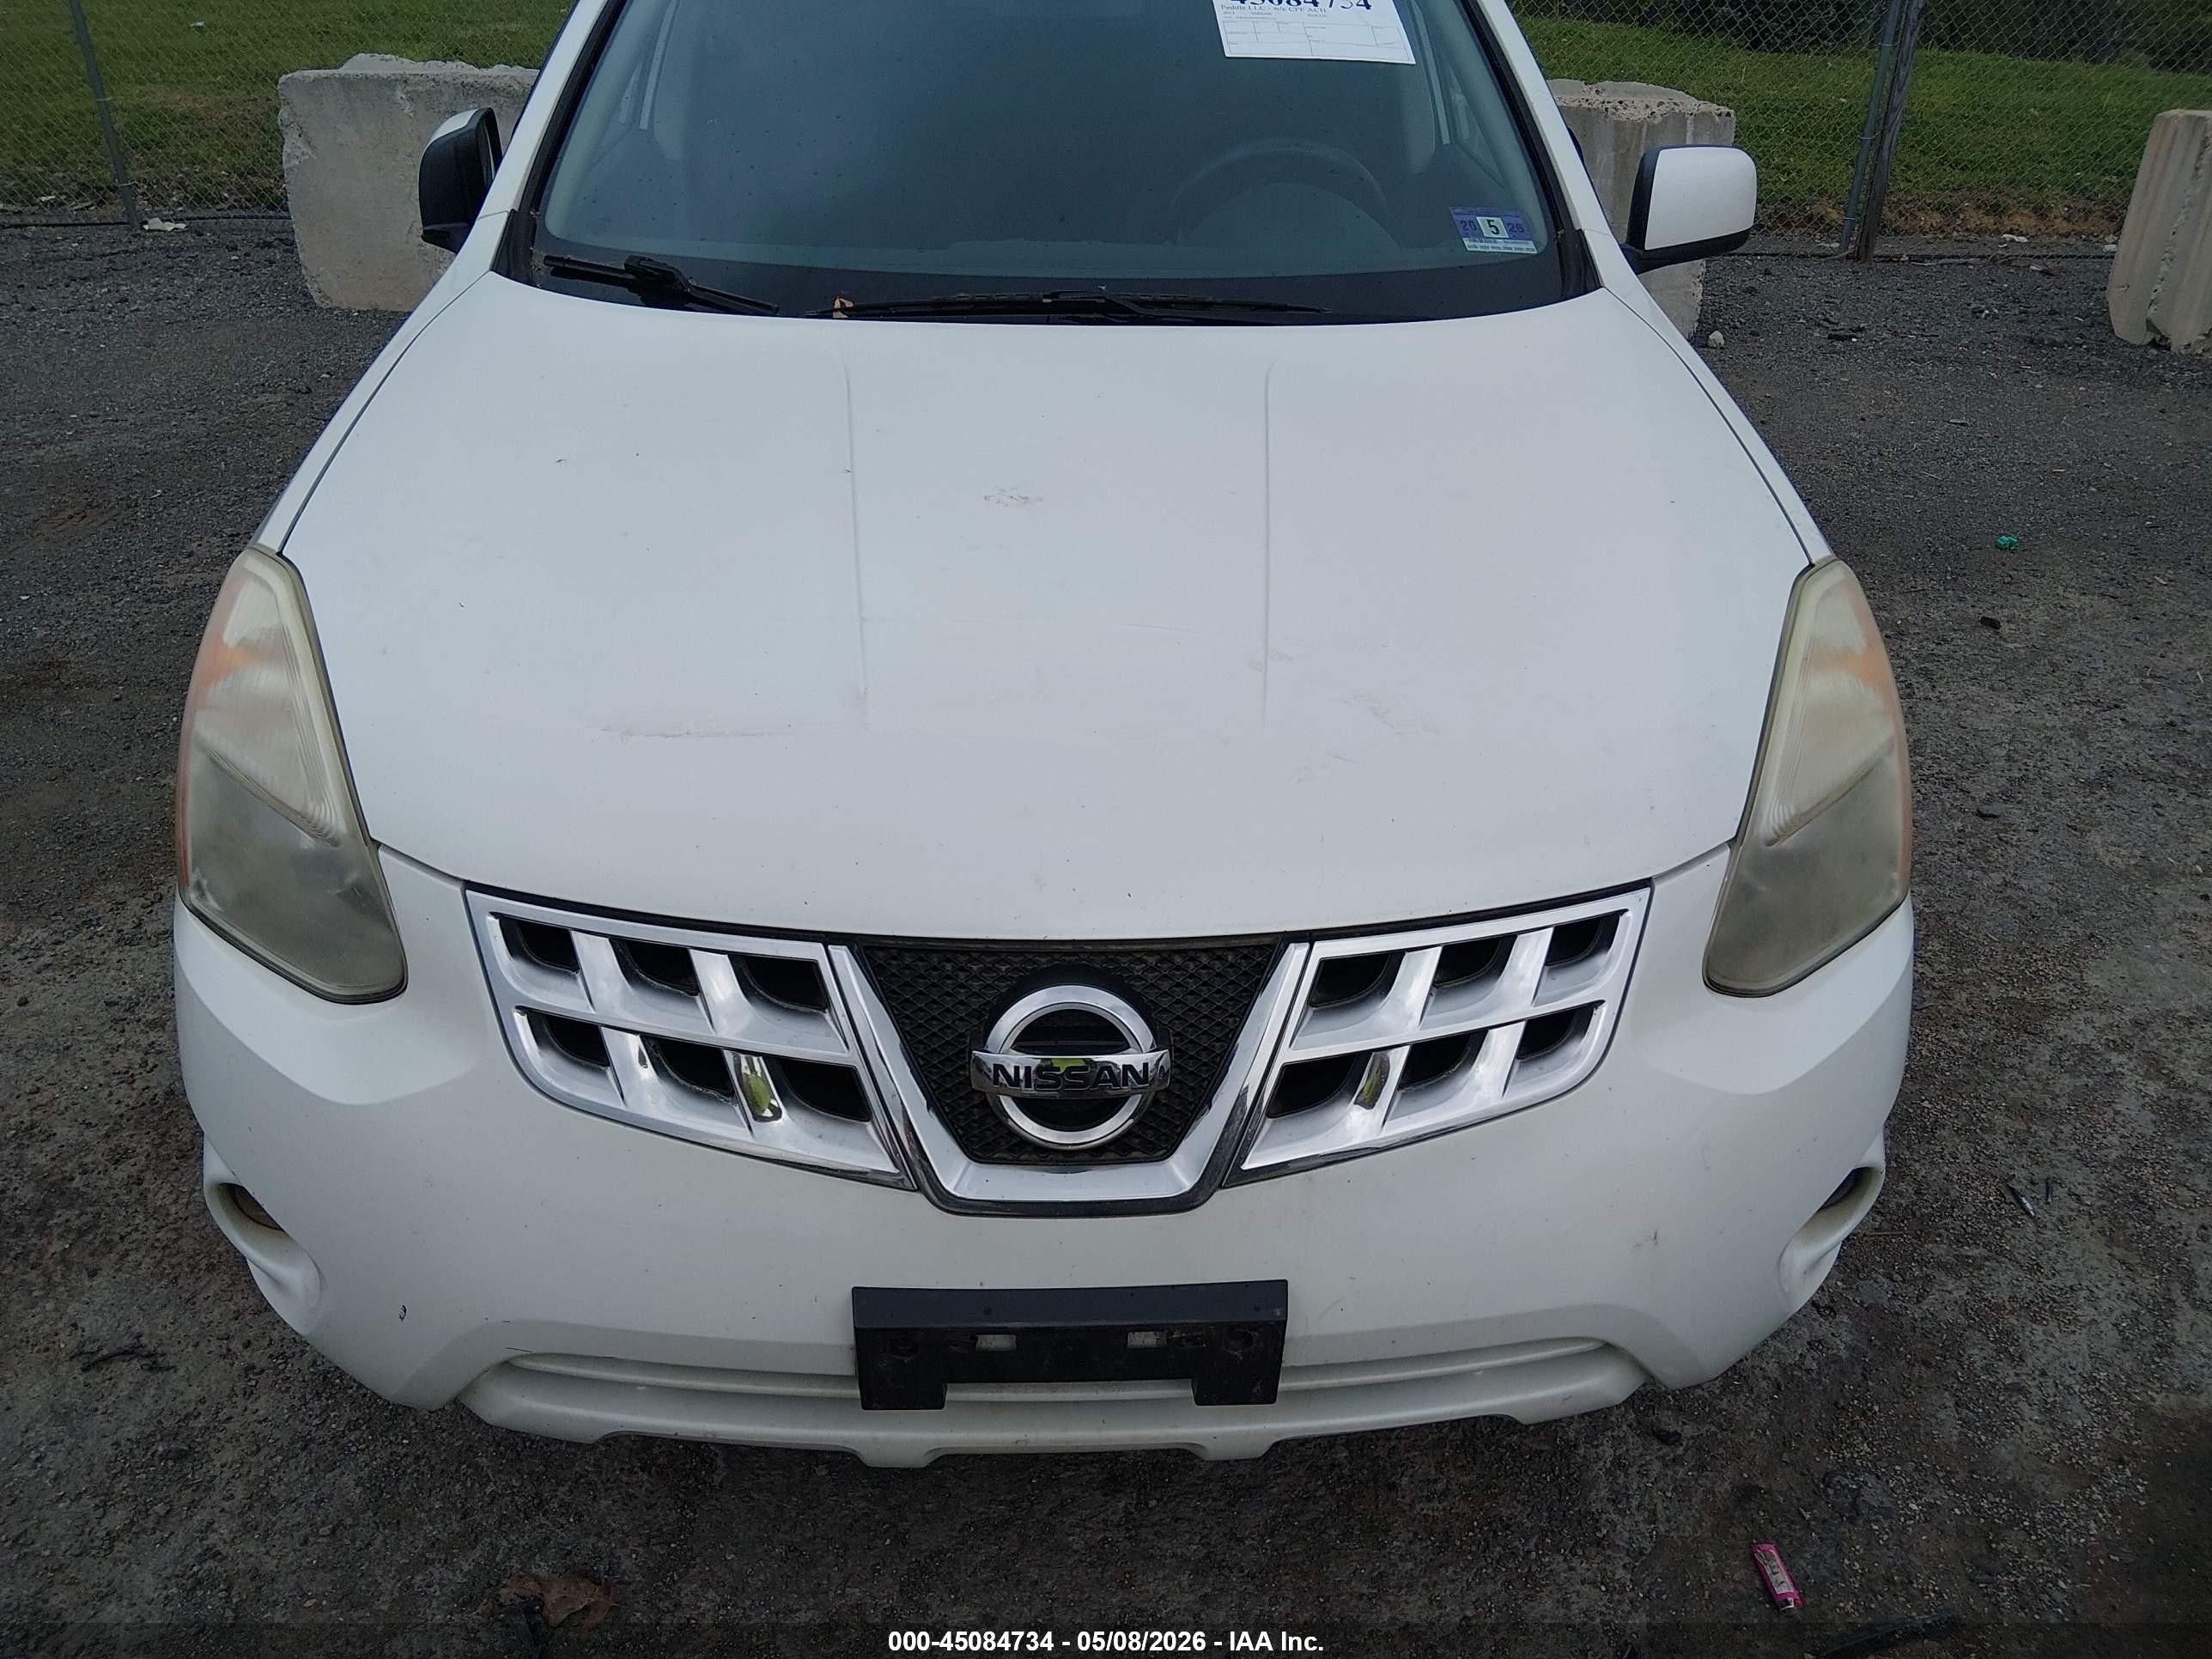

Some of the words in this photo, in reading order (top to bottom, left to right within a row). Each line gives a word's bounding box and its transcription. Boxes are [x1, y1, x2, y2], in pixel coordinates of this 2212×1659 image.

[1460, 220, 1477, 232] 20
[1486, 219, 1500, 235] 5
[1506, 222, 1525, 234] 26
[992, 1061, 1150, 1091] NISSAN
